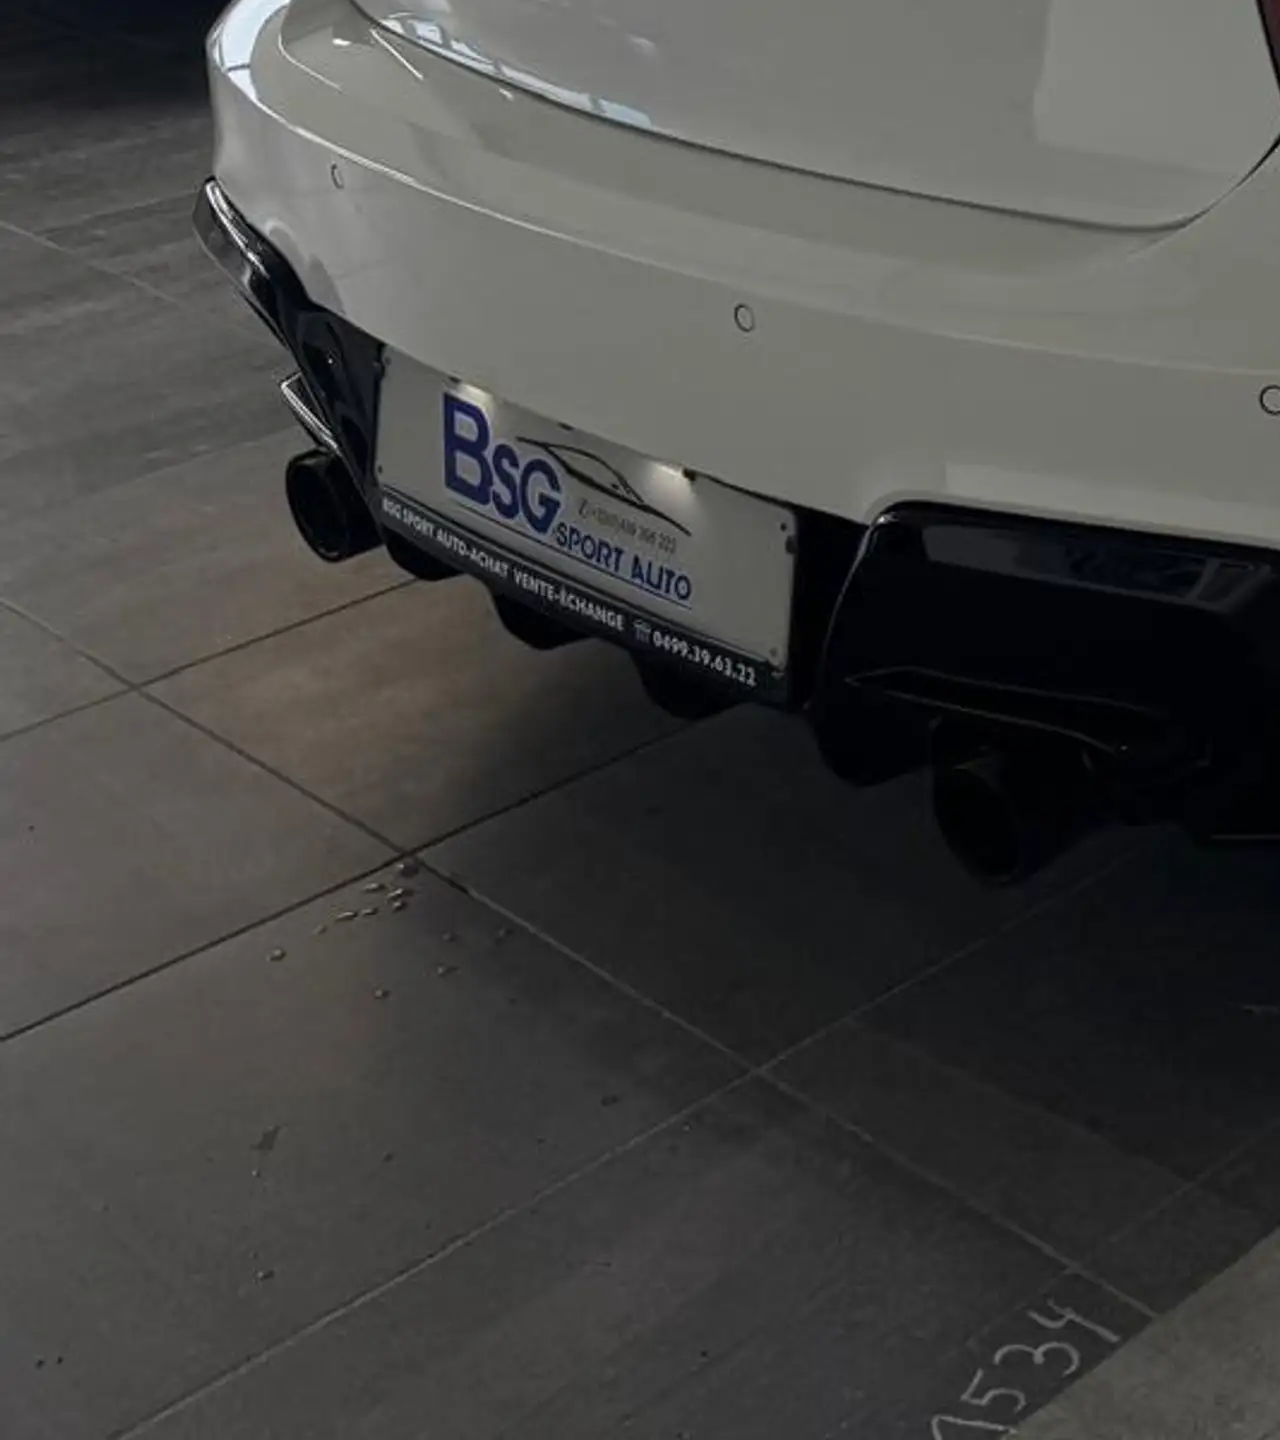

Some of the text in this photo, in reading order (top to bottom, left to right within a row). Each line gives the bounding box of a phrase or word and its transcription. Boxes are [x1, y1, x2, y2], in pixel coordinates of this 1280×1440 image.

[443, 392, 562, 535] BSG
[403, 509, 434, 538] SPORT
[556, 522, 624, 572] SPORT
[633, 554, 692, 601] AUTO
